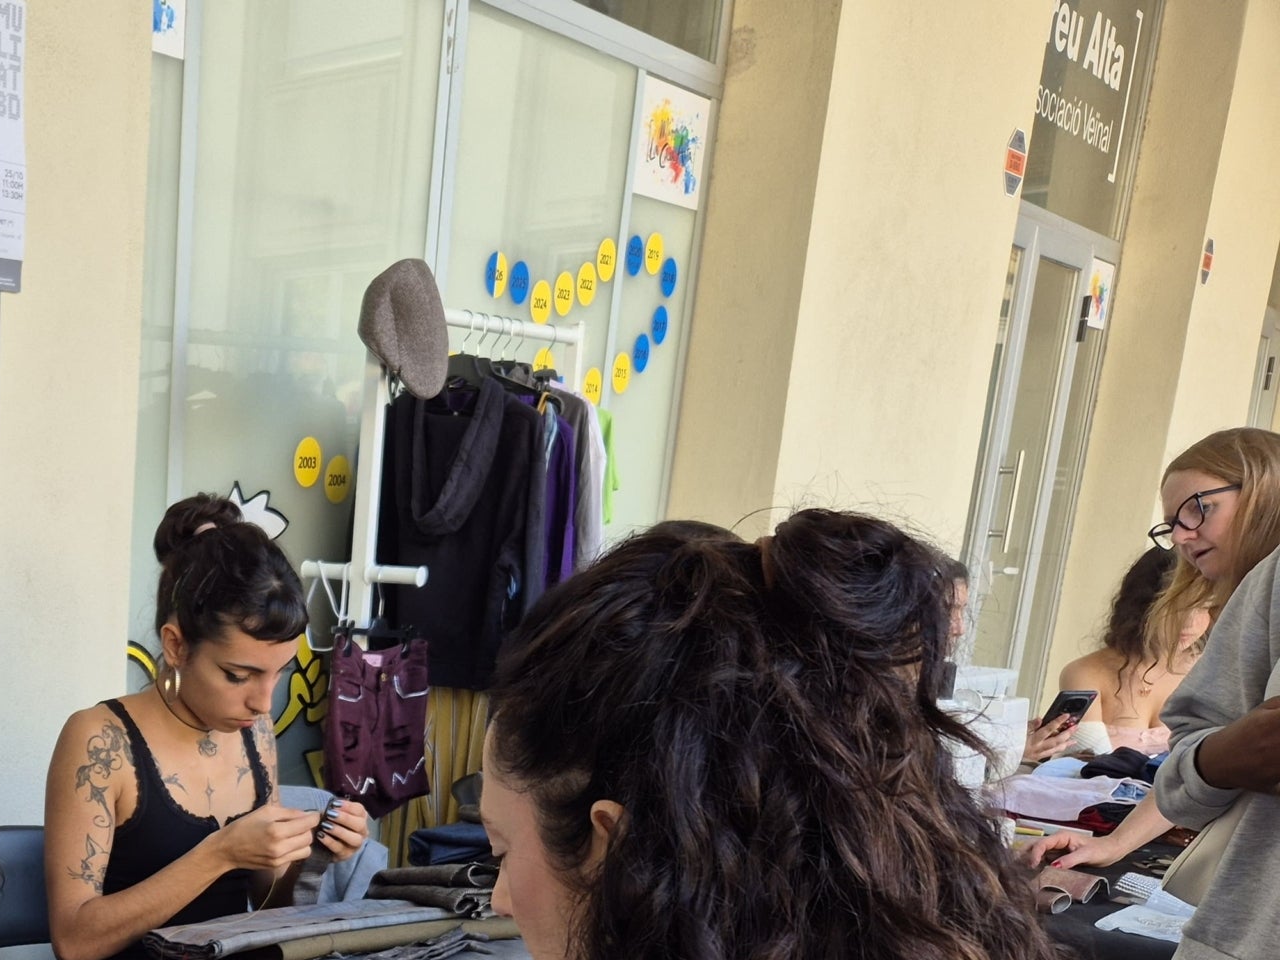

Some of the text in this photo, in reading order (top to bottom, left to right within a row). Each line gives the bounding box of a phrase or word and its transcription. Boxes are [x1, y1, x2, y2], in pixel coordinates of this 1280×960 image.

[1048, 0, 1124, 91] eu Alta
[1083, 103, 1113, 153] Veïnal
[600, 253, 612, 265] 2021
[579, 279, 593, 291] 2022
[533, 297, 547, 309] 2024
[585, 383, 598, 394] 2014
[298, 456, 316, 469] 2003
[328, 474, 346, 487] 2004
